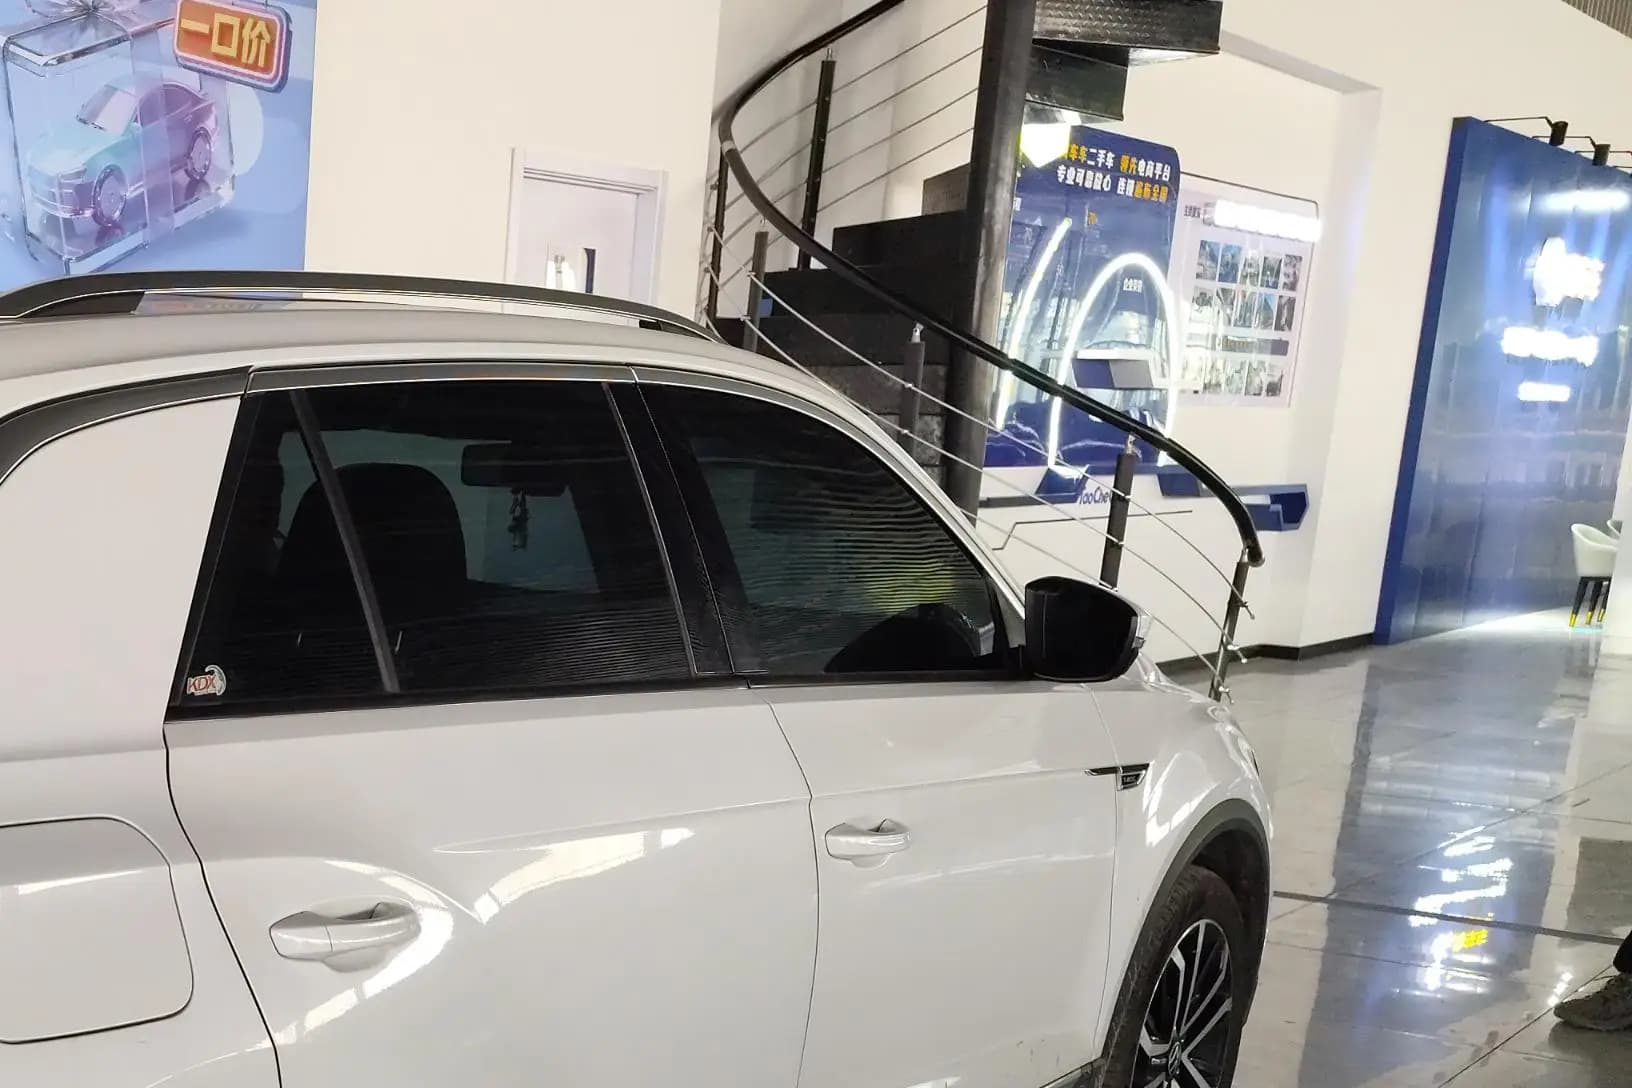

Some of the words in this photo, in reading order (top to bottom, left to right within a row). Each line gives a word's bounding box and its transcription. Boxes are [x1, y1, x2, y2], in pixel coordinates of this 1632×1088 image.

[180, 12, 271, 69] 一口价
[1067, 143, 1115, 169] 车车二手车
